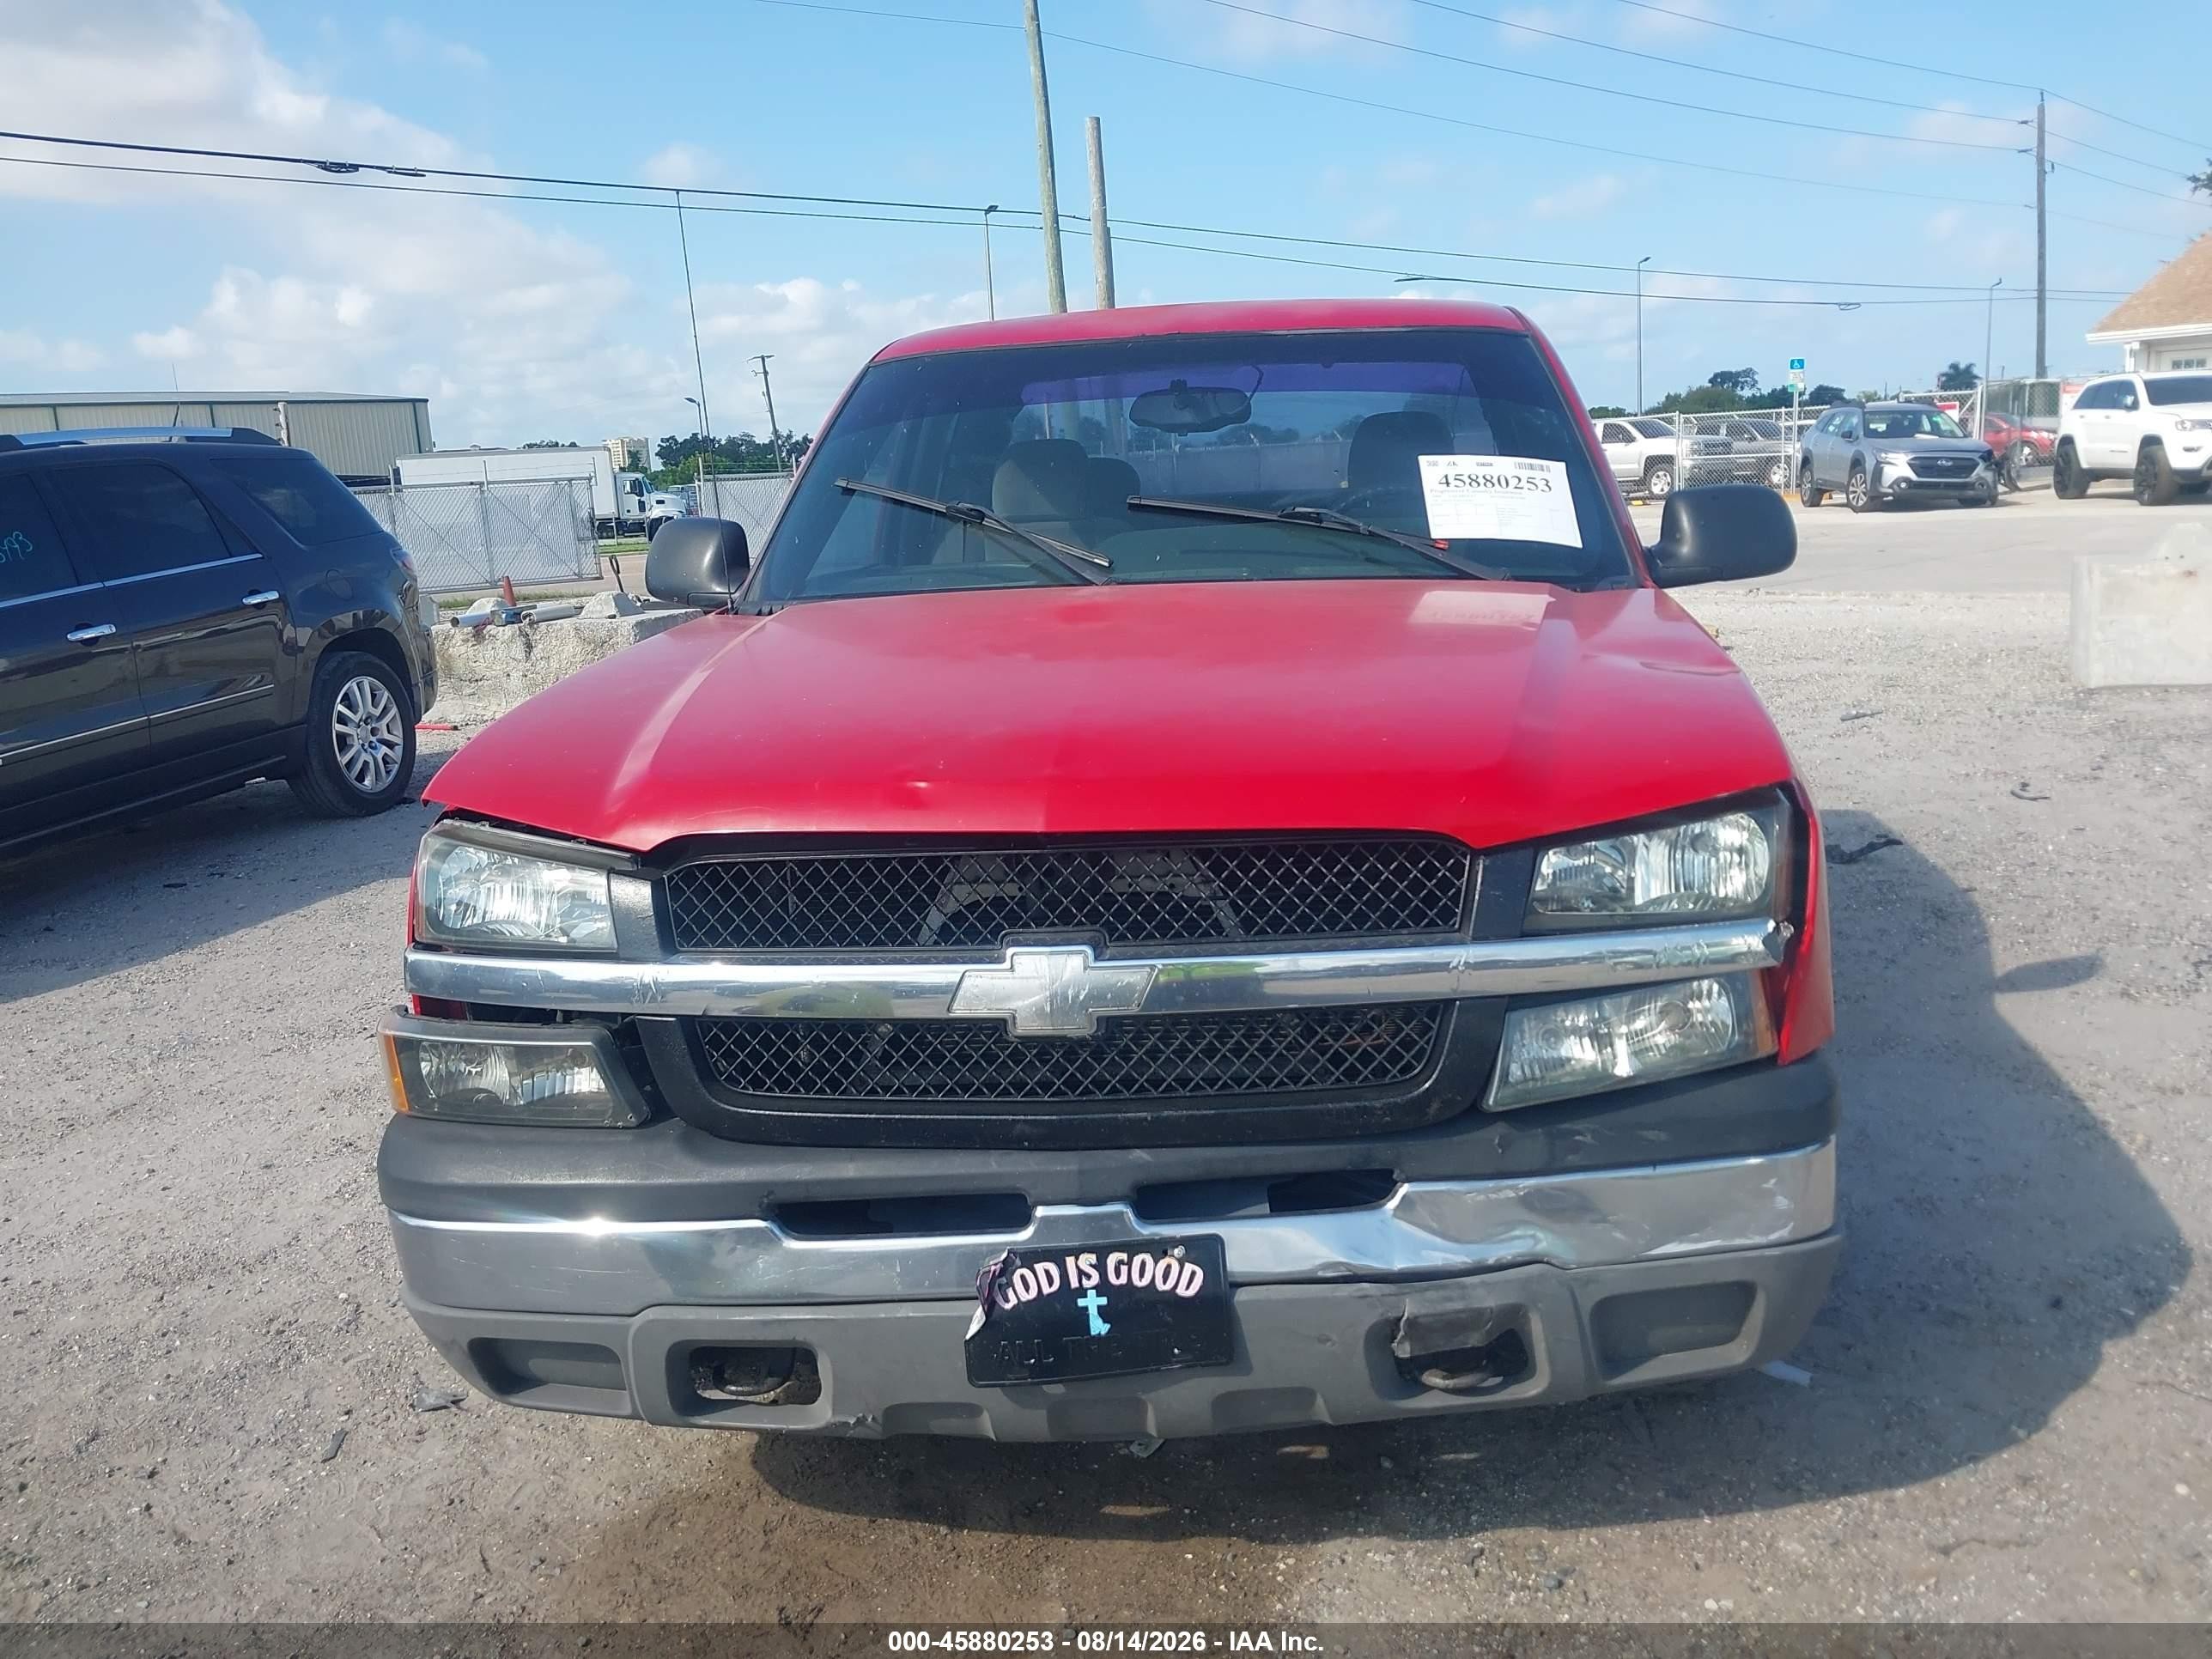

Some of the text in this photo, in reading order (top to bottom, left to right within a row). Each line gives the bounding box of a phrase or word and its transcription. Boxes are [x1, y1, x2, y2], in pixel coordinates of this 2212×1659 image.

[1438, 473, 1553, 494] 45880253
[993, 1251, 1205, 1310] GOD IS GOOD
